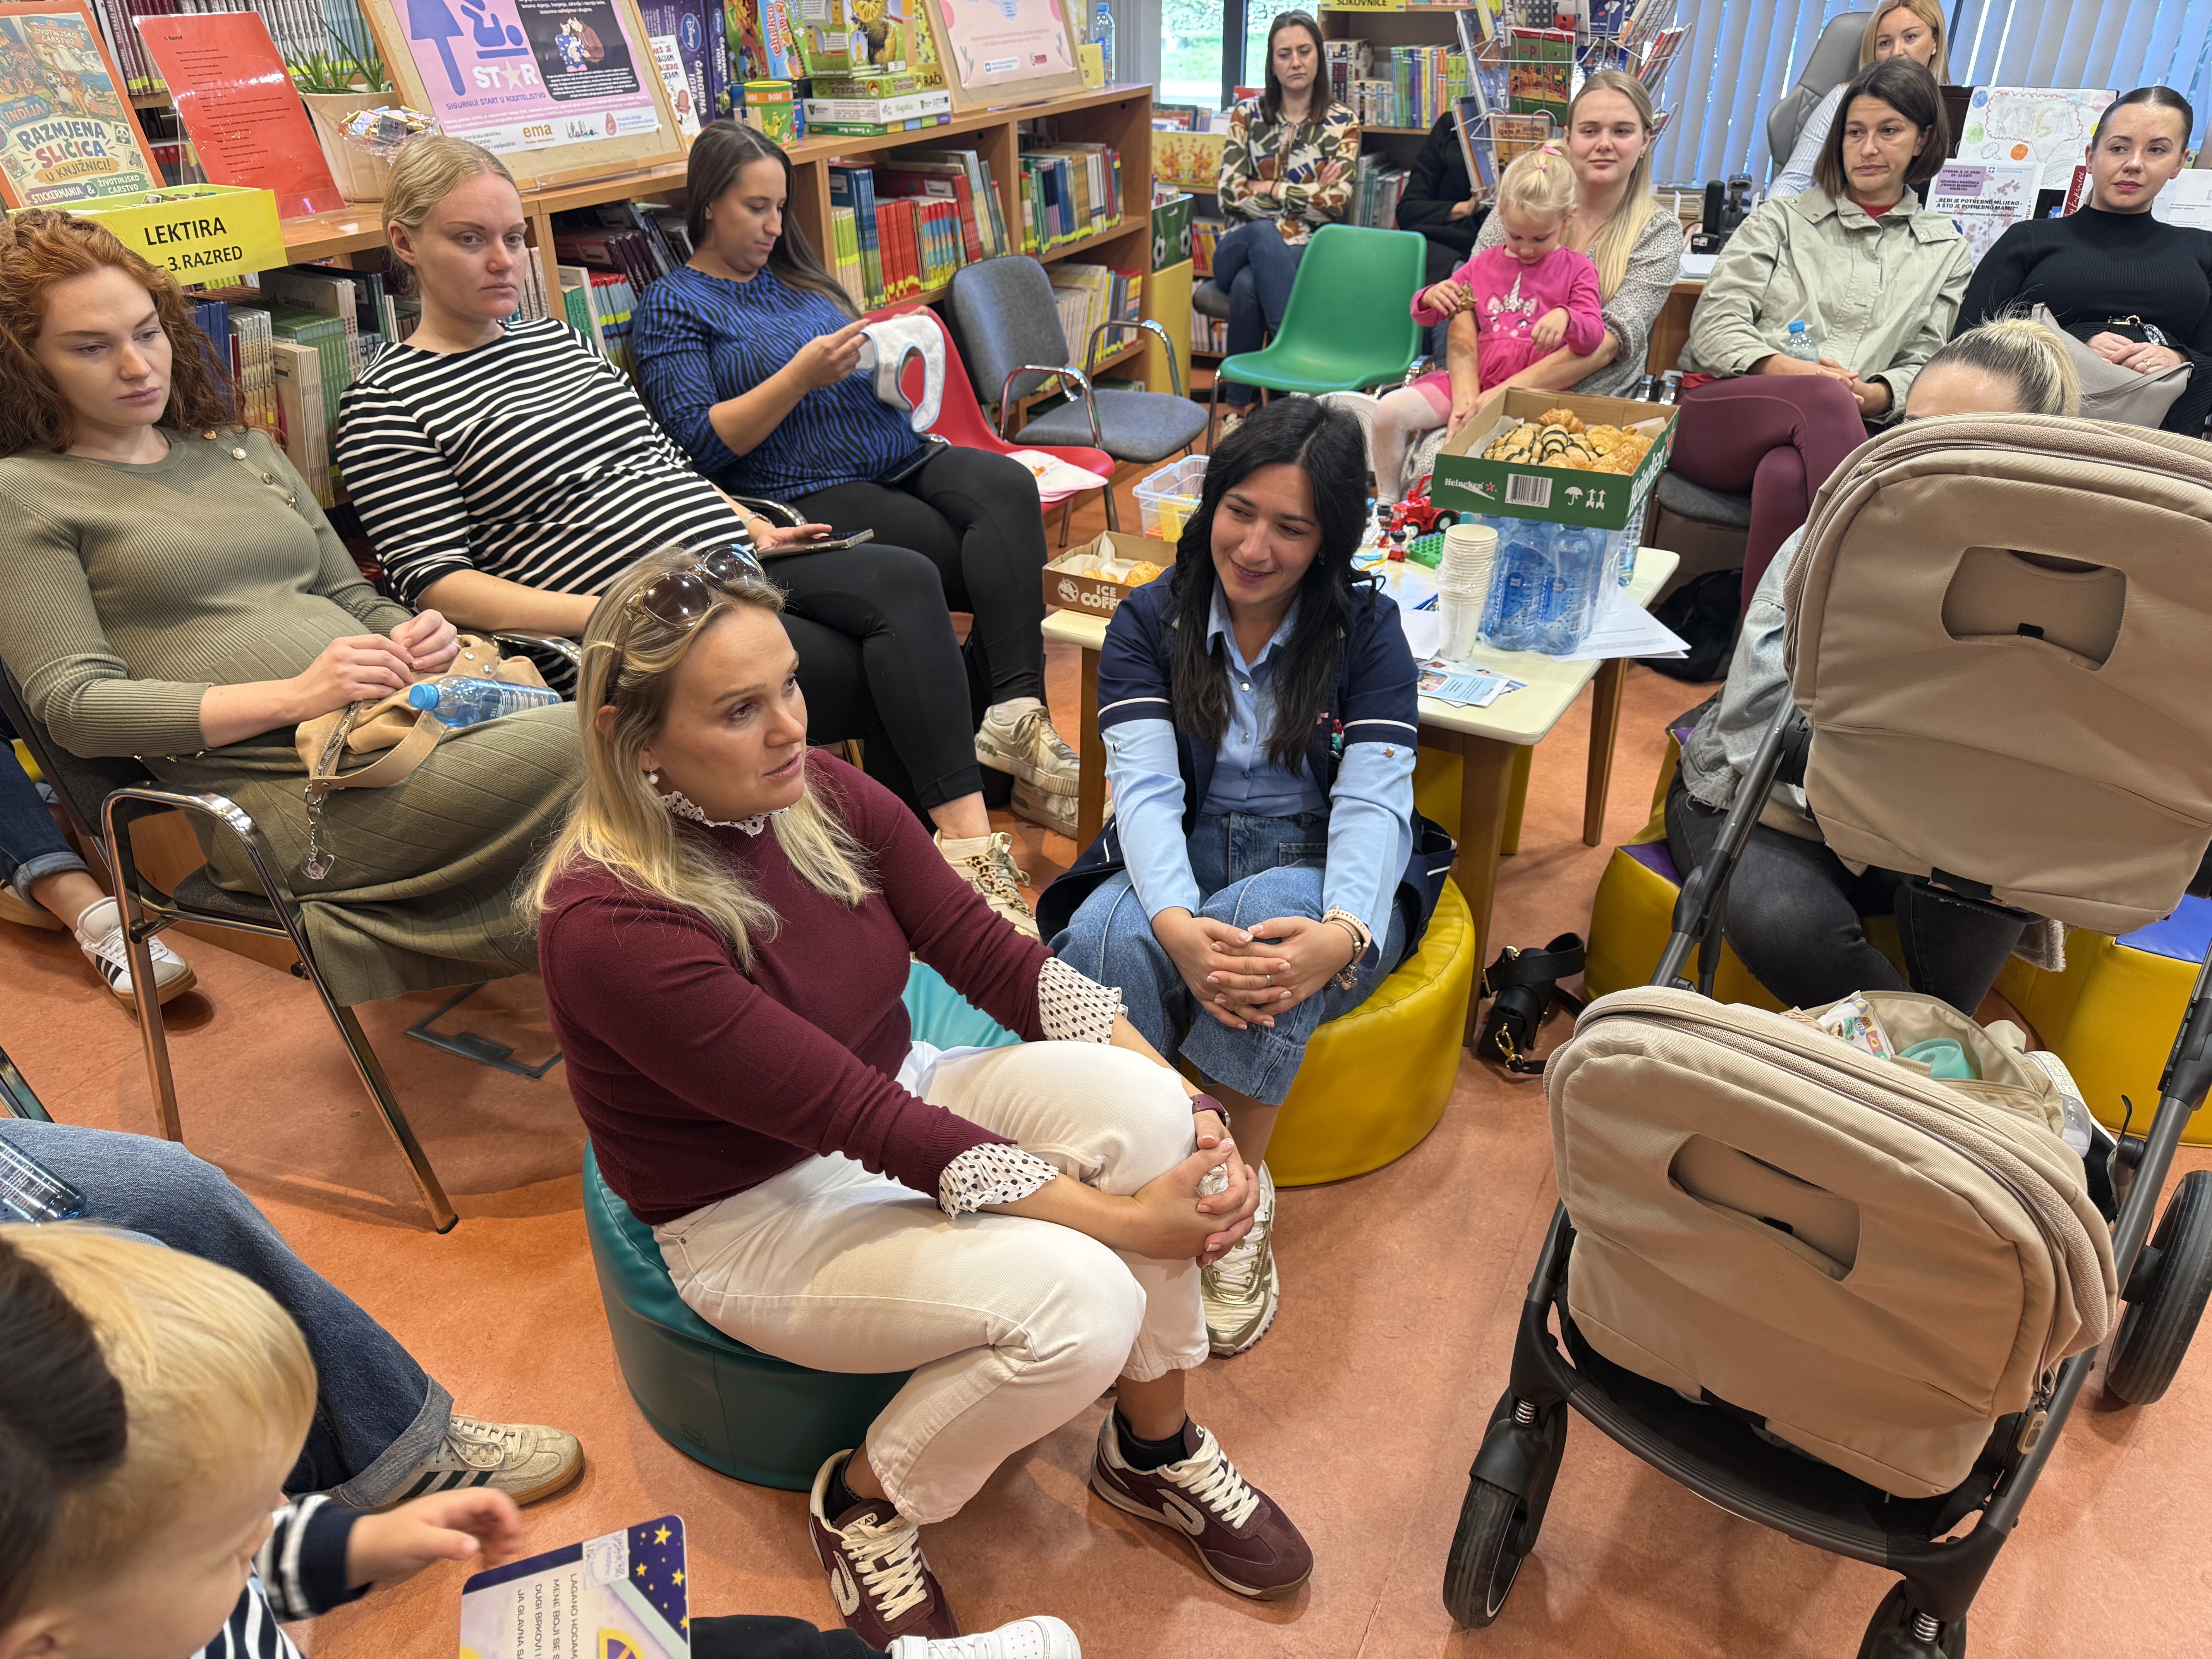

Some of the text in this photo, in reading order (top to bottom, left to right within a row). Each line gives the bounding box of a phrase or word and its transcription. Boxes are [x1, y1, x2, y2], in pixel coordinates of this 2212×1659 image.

[34, 27, 77, 39] ŽIVOTINJSKO
[42, 34, 75, 45] CARSTVO
[686, 19, 696, 49] Disney
[766, 5, 782, 56] Chicken
[689, 74, 697, 100] IGRA
[695, 60, 707, 114] ČAROBNA
[446, 98, 480, 110] SIGURNIJI
[480, 96, 499, 105] START
[506, 92, 546, 103] RODITELJSTVO
[4, 103, 46, 124] INDIJA
[16, 121, 106, 151] RAZMJENA
[522, 123, 553, 139] ema
[35, 138, 107, 168] SLIČICA
[45, 159, 112, 182] U KNJIŽNICI!
[97, 173, 140, 187] ŽIVOTINJSKO
[31, 185, 96, 204] STICKERMANIA &
[108, 184, 139, 195] CARSTVO
[144, 217, 227, 246] LEKTIRA
[168, 256, 181, 271] 3.
[182, 246, 243, 269] RAZRED
[1445, 478, 1483, 489] Heineken
[1096, 585, 1116, 598] ICE
[517, 1589, 524, 1603] JA
[553, 1637, 560, 1652] SE
